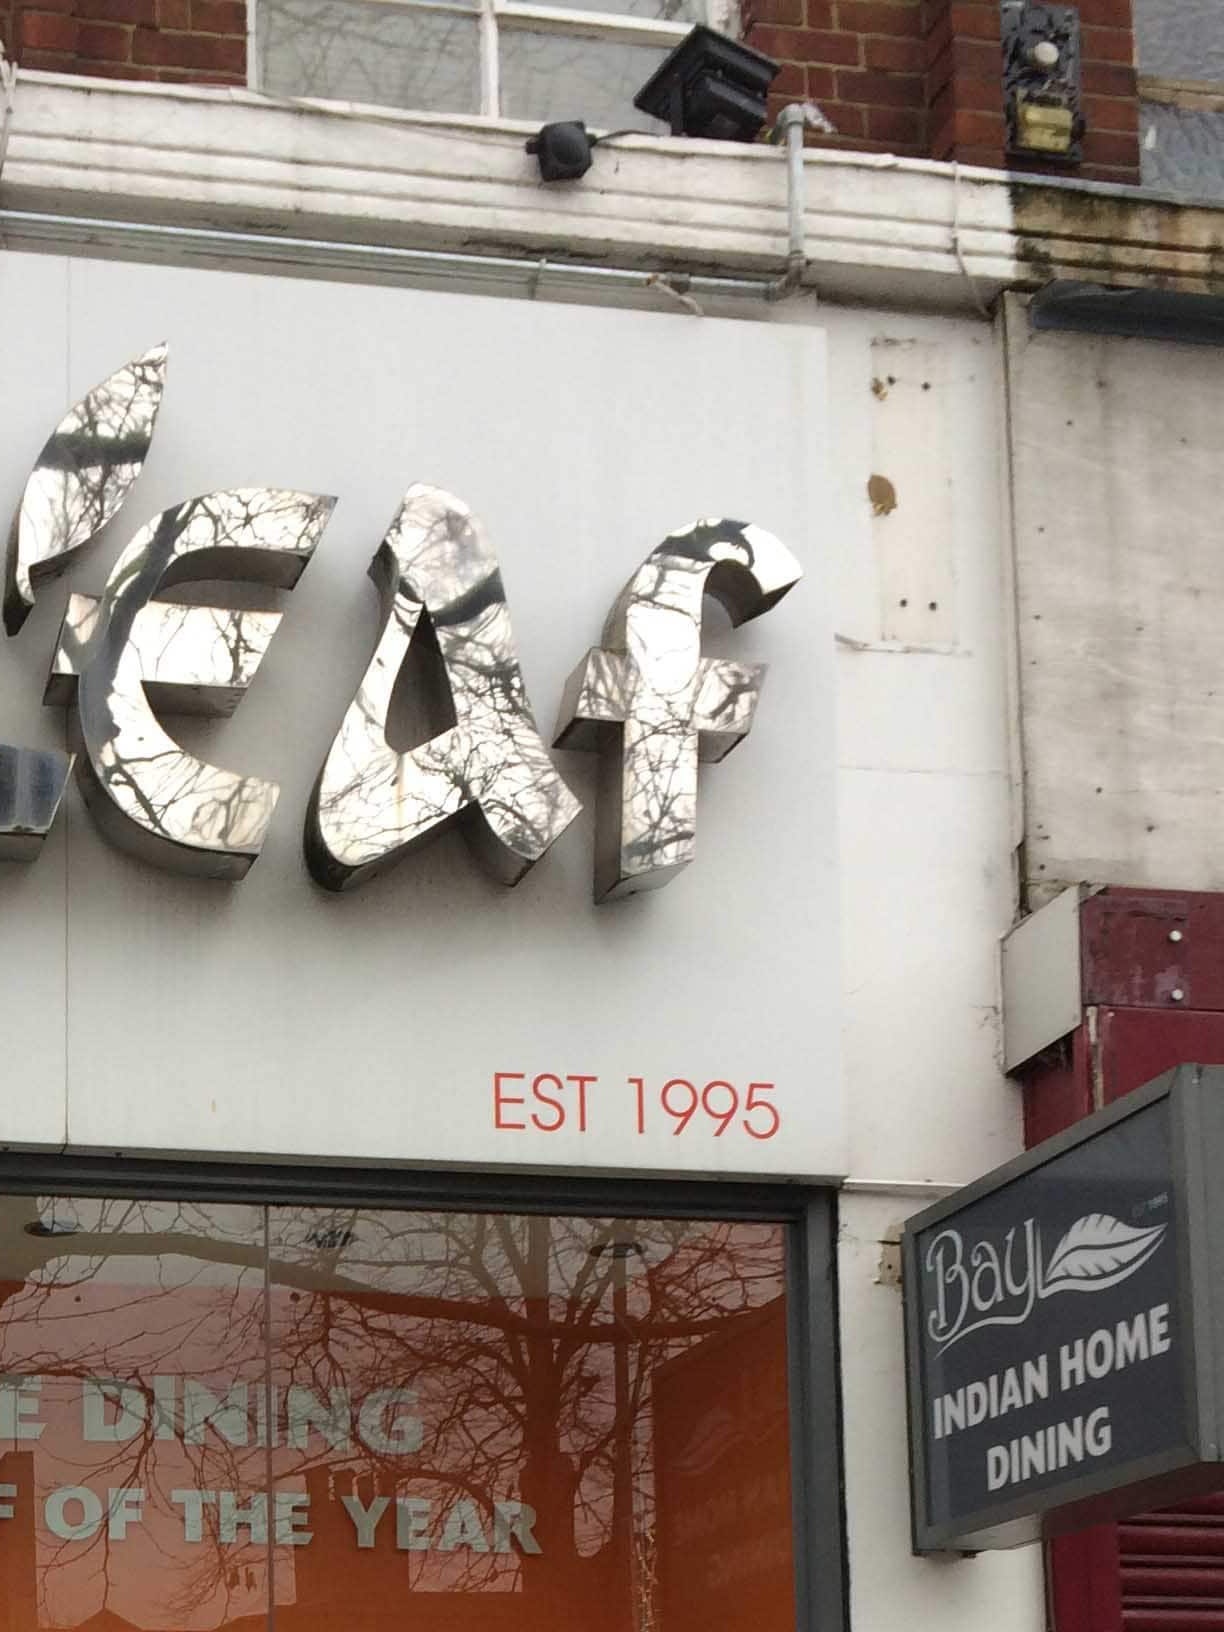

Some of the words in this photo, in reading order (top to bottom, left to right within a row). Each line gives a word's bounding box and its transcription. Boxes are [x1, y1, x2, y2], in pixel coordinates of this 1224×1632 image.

[494, 1072, 598, 1131] EST
[628, 1078, 780, 1139] 1995
[926, 1217, 1038, 1360] Bay
[84, 1371, 424, 1455] DINING
[934, 1354, 1049, 1439] INDIAN
[1060, 1303, 1171, 1391] HOME
[987, 1407, 1112, 1491] DINING
[45, 1486, 143, 1541] OF
[173, 1490, 313, 1545] THE
[342, 1496, 542, 1554] YEAR
